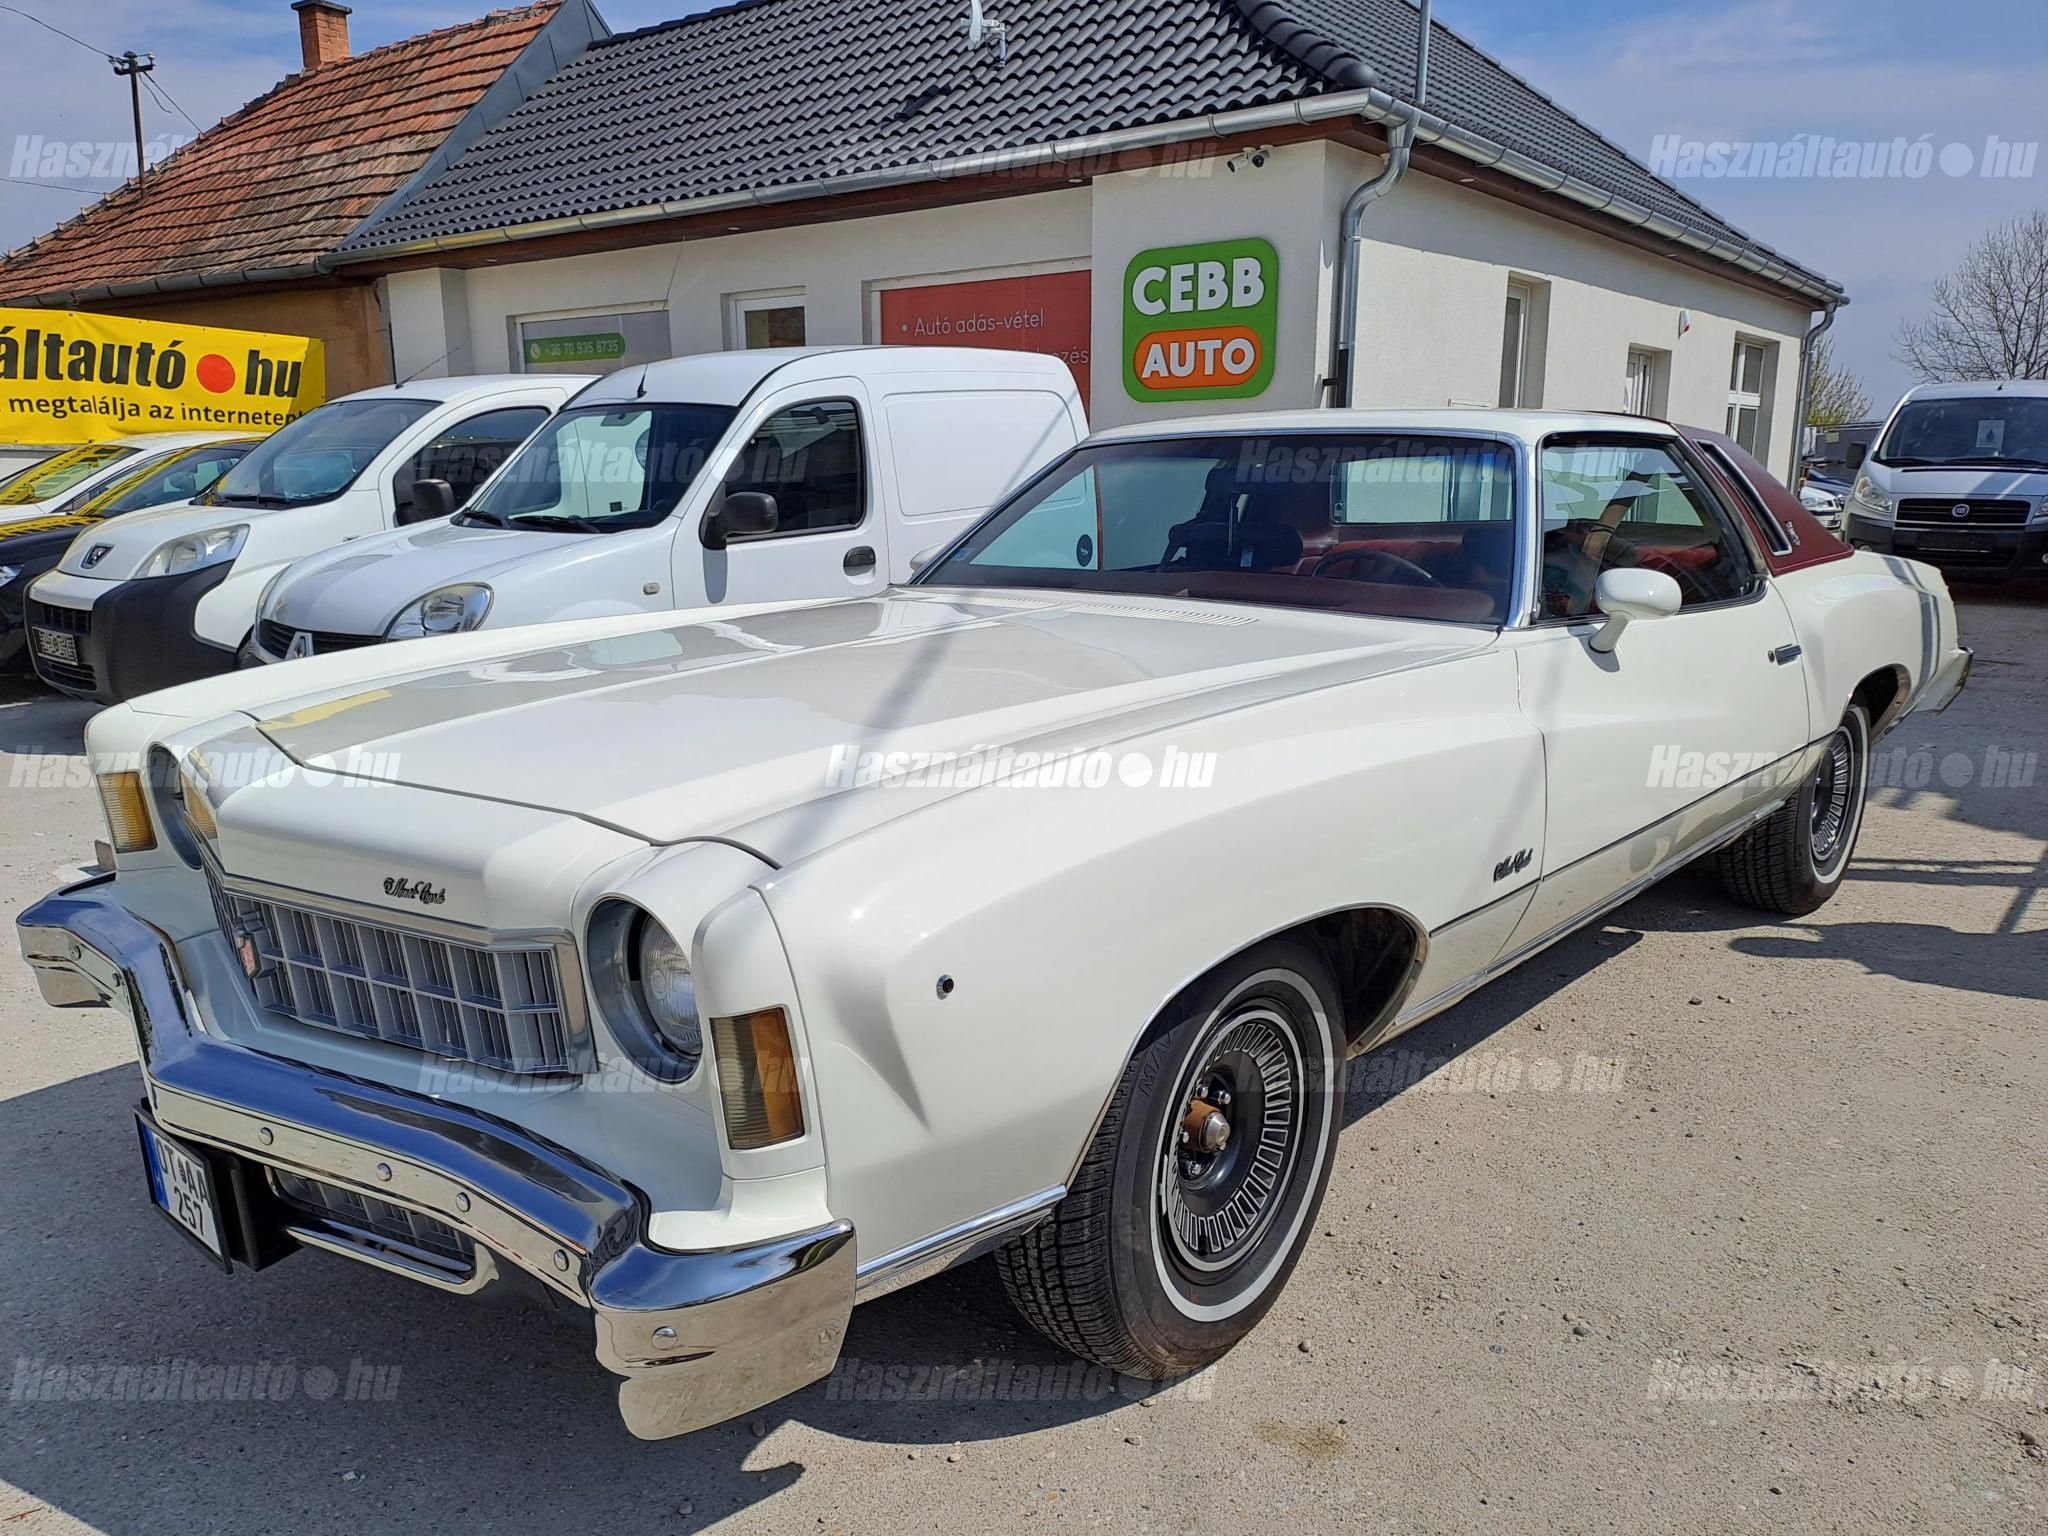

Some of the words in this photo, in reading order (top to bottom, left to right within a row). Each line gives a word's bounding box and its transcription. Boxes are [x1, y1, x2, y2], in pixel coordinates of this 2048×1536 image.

[1132, 257, 1265, 316] CEBB
[914, 316, 951, 337] Autó
[956, 305, 1044, 334] adás-vétel
[564, 342, 574, 355] 70
[1141, 338, 1255, 379] AUTO
[244, 350, 302, 398] hu
[9, 395, 141, 422] megtalálja
[148, 404, 175, 420] az
[174, 1186, 204, 1237] 257
